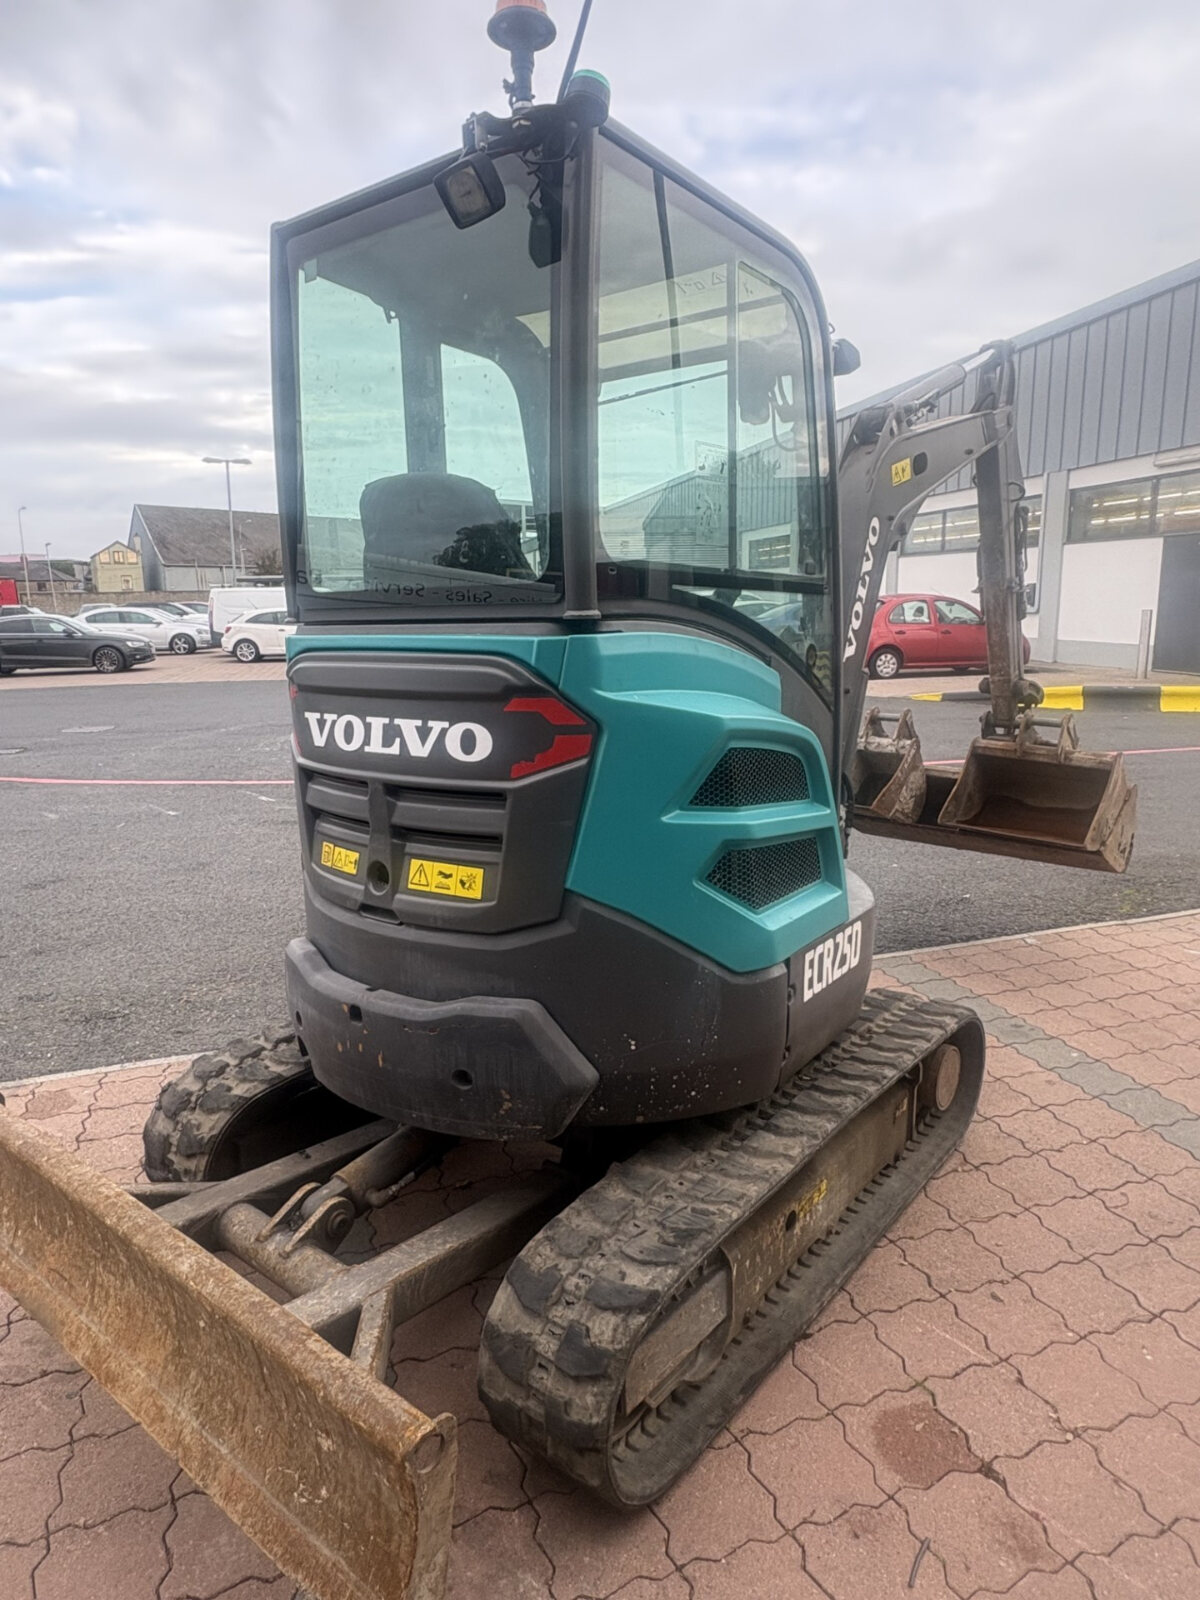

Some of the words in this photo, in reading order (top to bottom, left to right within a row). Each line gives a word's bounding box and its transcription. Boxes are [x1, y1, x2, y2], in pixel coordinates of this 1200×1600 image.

[843, 516, 880, 663] VOLVO
[304, 711, 493, 763] VOLVO
[803, 920, 863, 1003] ECR25D
